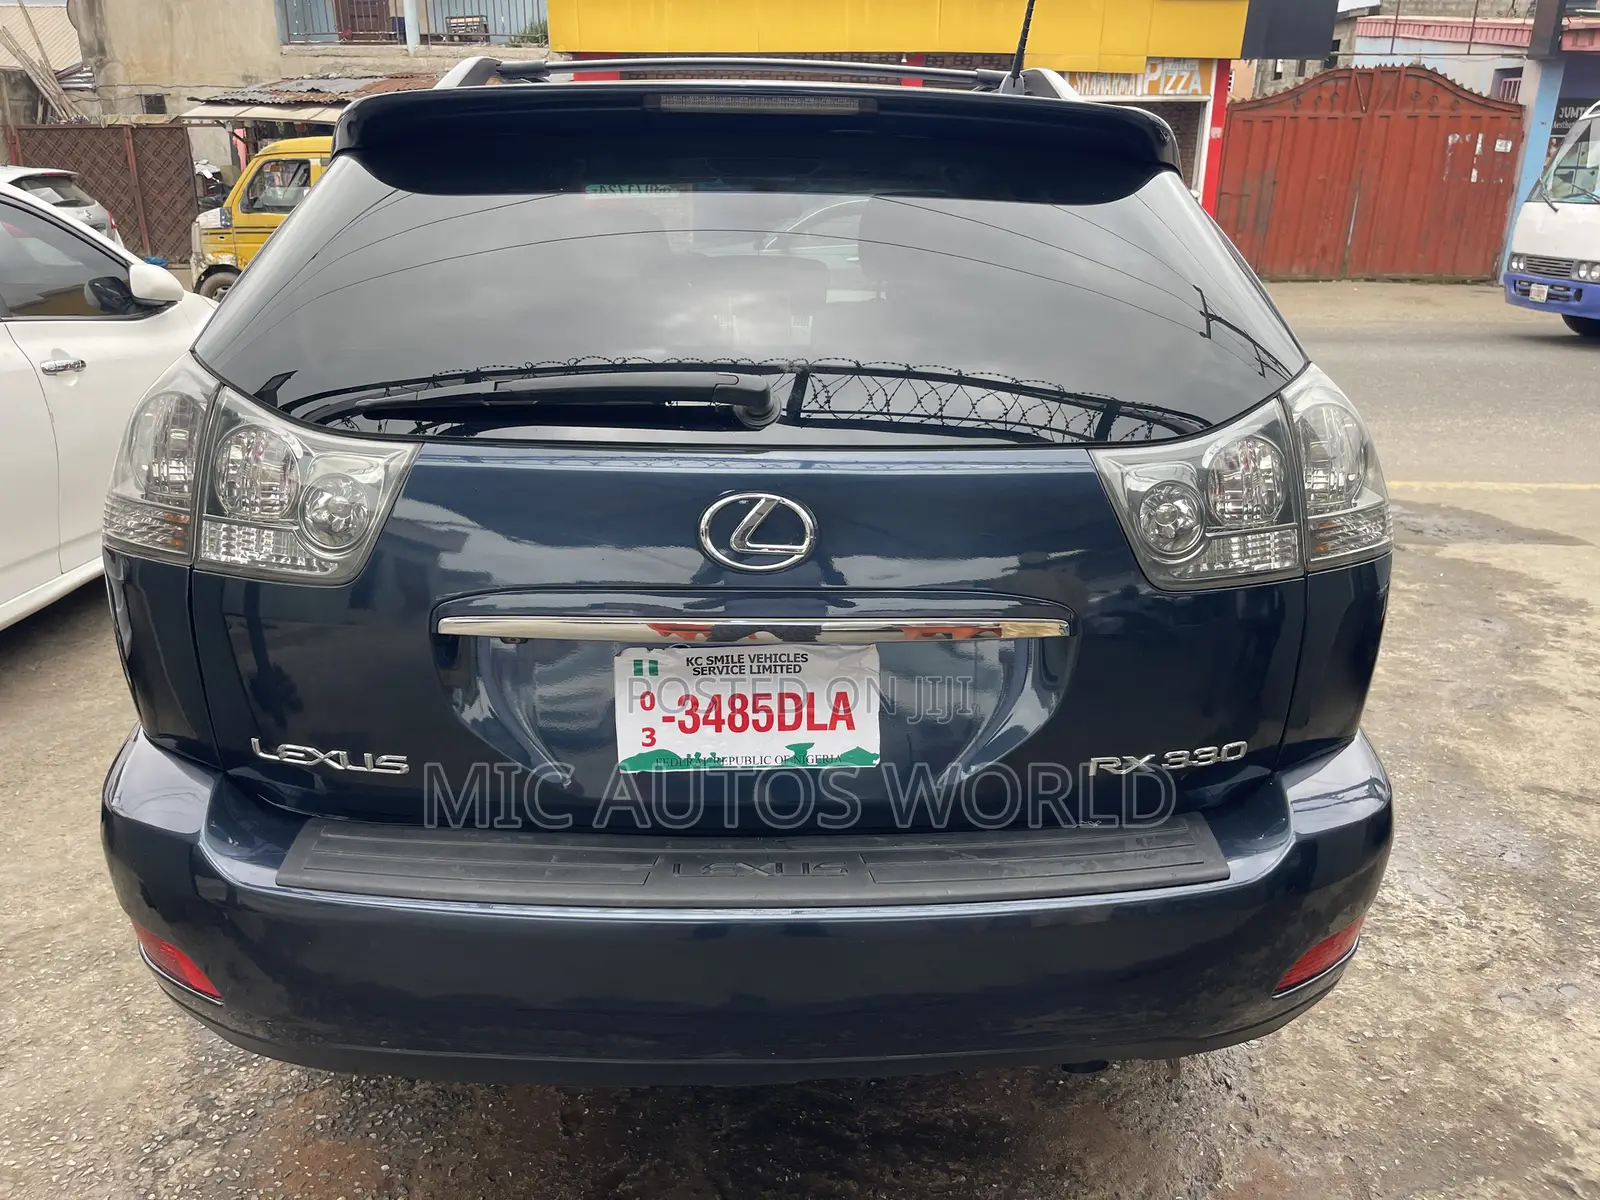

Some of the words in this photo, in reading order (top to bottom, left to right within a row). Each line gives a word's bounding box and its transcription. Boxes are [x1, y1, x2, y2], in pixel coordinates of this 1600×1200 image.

[1144, 60, 1202, 96] PIZZA
[1559, 106, 1590, 119] JUMT
[686, 656, 703, 667] KC
[706, 654, 745, 666] SMILE
[748, 653, 809, 664] VEHICLES
[692, 665, 746, 676] SERVICE
[750, 664, 803, 674] LIMITED
[641, 727, 657, 747] 3
[250, 737, 411, 775] LEXUS
[655, 757, 708, 767] FEDERAL
[713, 755, 771, 766] REPUBLIC
[774, 755, 788, 765] OF
[792, 753, 843, 765] NIGERIA
[1089, 754, 1156, 777] RX
[1161, 740, 1248, 770] 330
[672, 861, 849, 877] LEXUS
